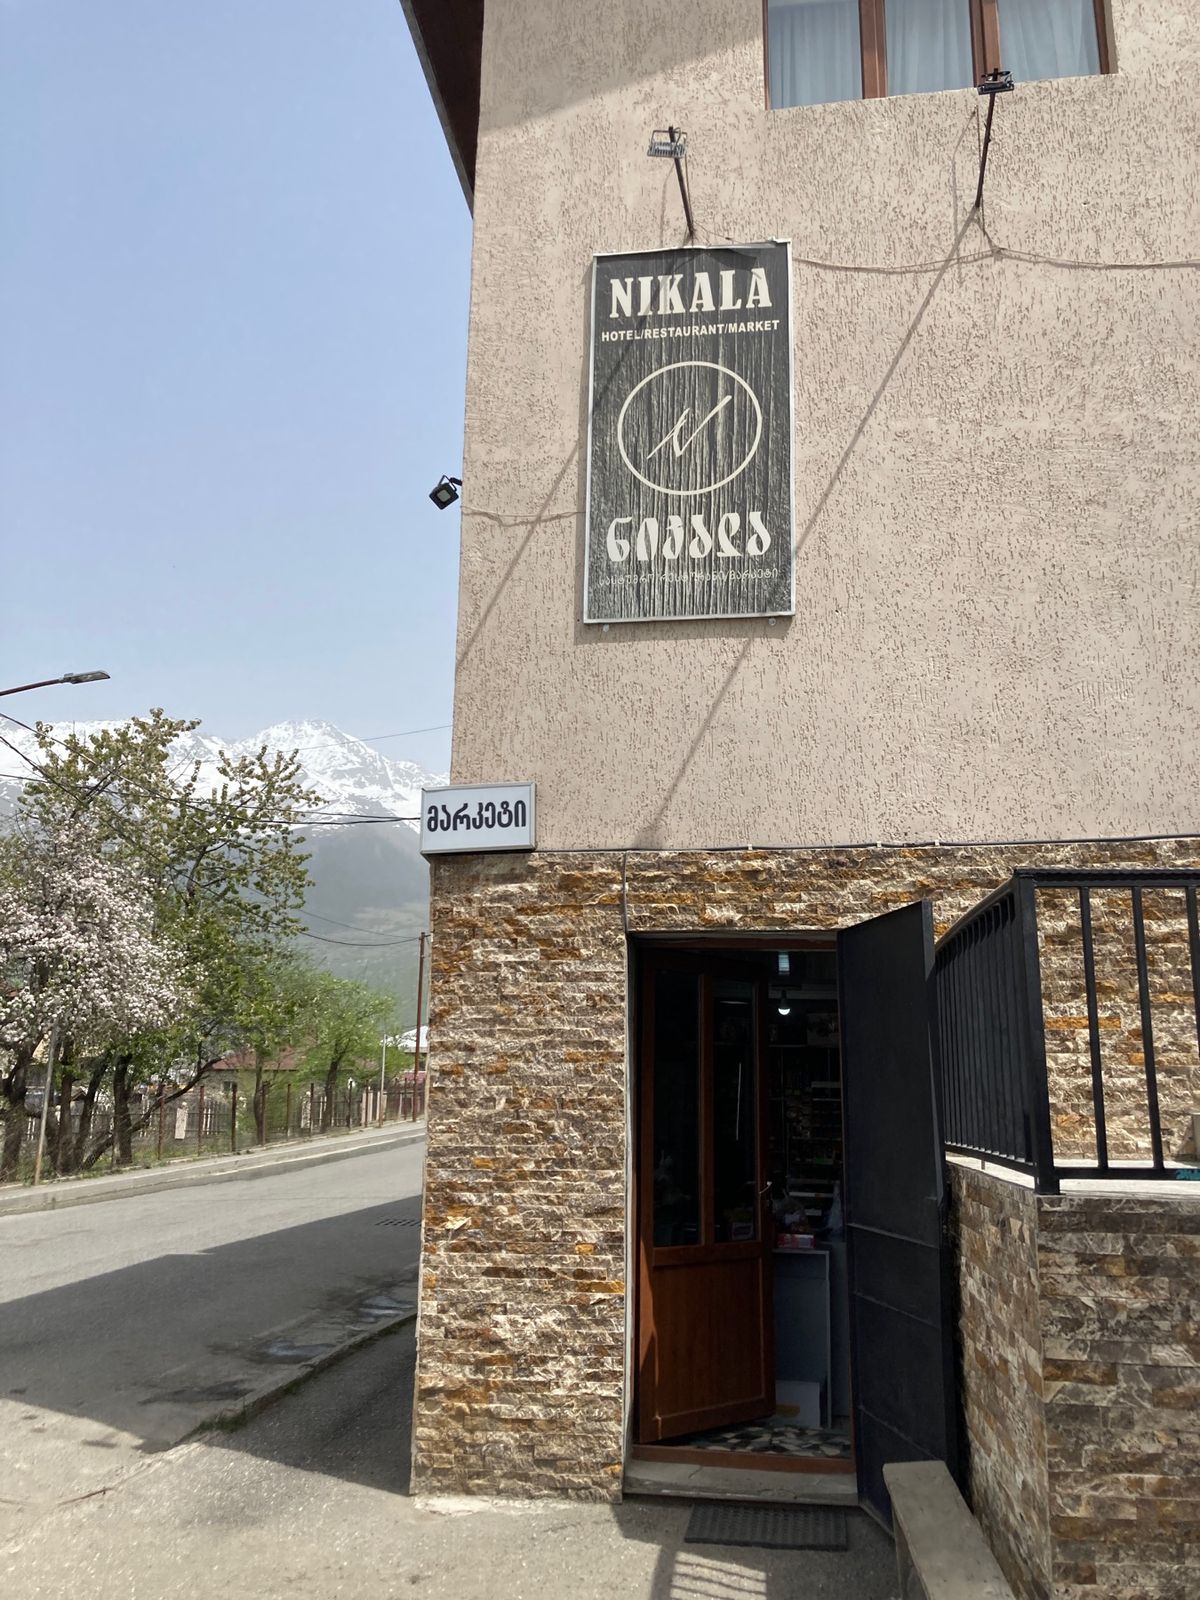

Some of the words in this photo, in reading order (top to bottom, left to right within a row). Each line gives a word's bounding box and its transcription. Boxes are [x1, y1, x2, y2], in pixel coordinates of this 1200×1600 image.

[609, 267, 772, 318] NIKALA
[601, 319, 780, 342] HOTEL/RESTAURANT/MARKET
[606, 511, 771, 562] ნიკალა
[427, 800, 526, 832] მარკეტი
